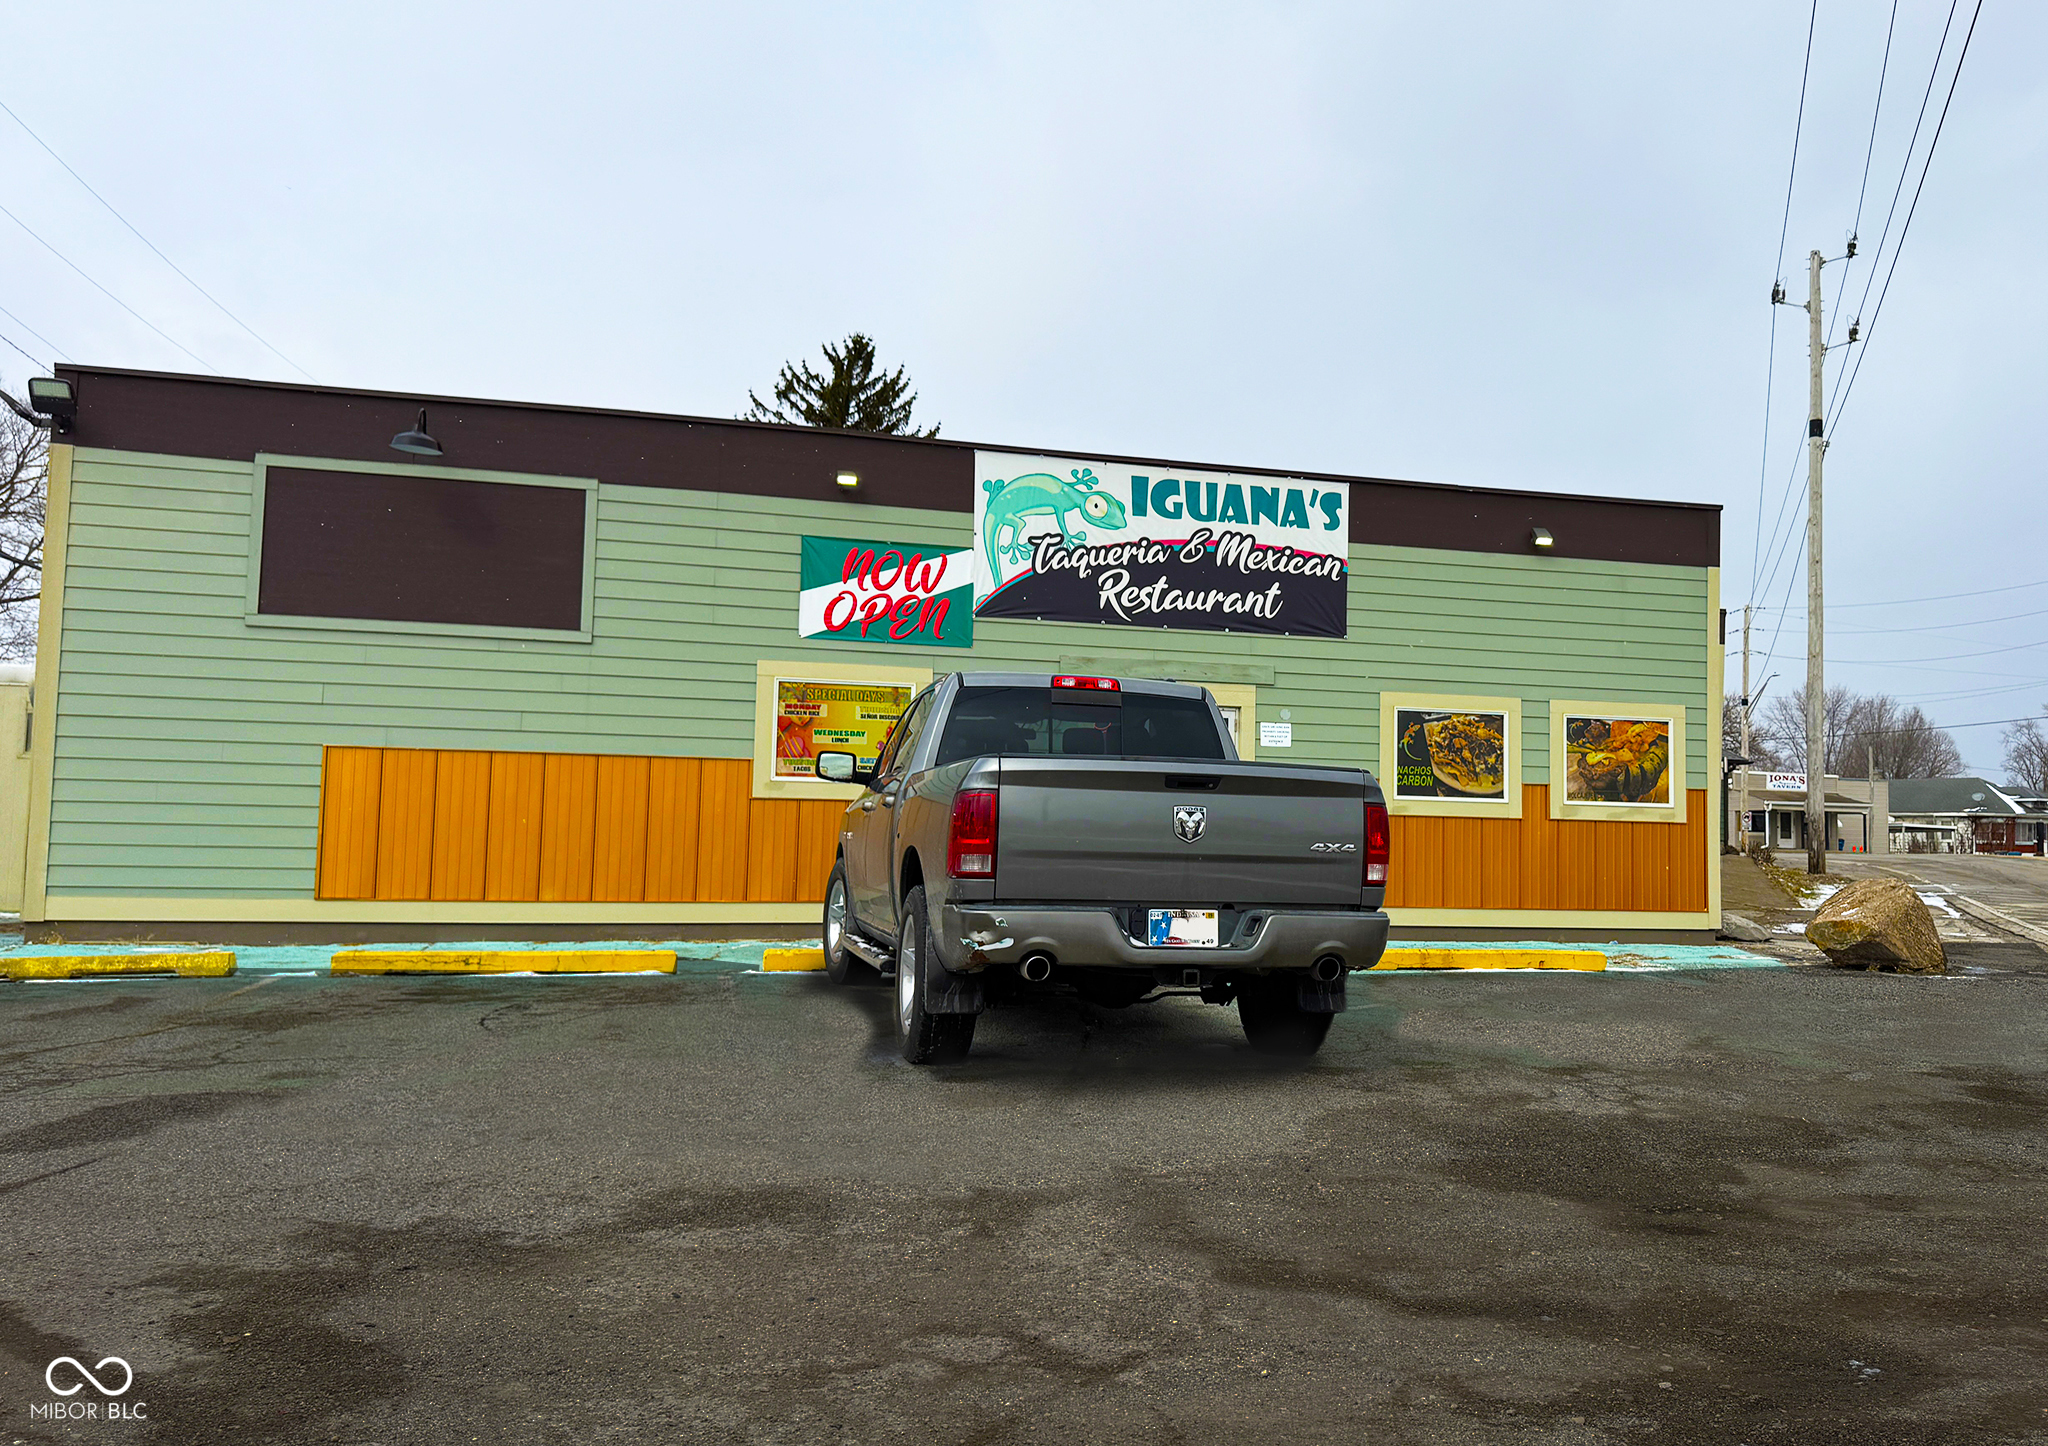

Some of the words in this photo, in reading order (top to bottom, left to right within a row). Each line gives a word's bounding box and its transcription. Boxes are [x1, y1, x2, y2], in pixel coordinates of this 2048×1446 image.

[1131, 475, 1342, 532] IGUANA'S
[1031, 534, 1169, 577] Taqueria
[1178, 528, 1213, 564] &
[1214, 532, 1343, 582] Mexican
[841, 547, 948, 594] NOW
[1098, 568, 1283, 622] Restaurant
[806, 688, 854, 702] SPECIAL
[855, 690, 885, 703] DAYS
[785, 703, 822, 711] MONDAY
[814, 729, 866, 737] WEDNESDAY
[1397, 766, 1432, 775] NACHOS
[1397, 775, 1434, 787] CARBON
